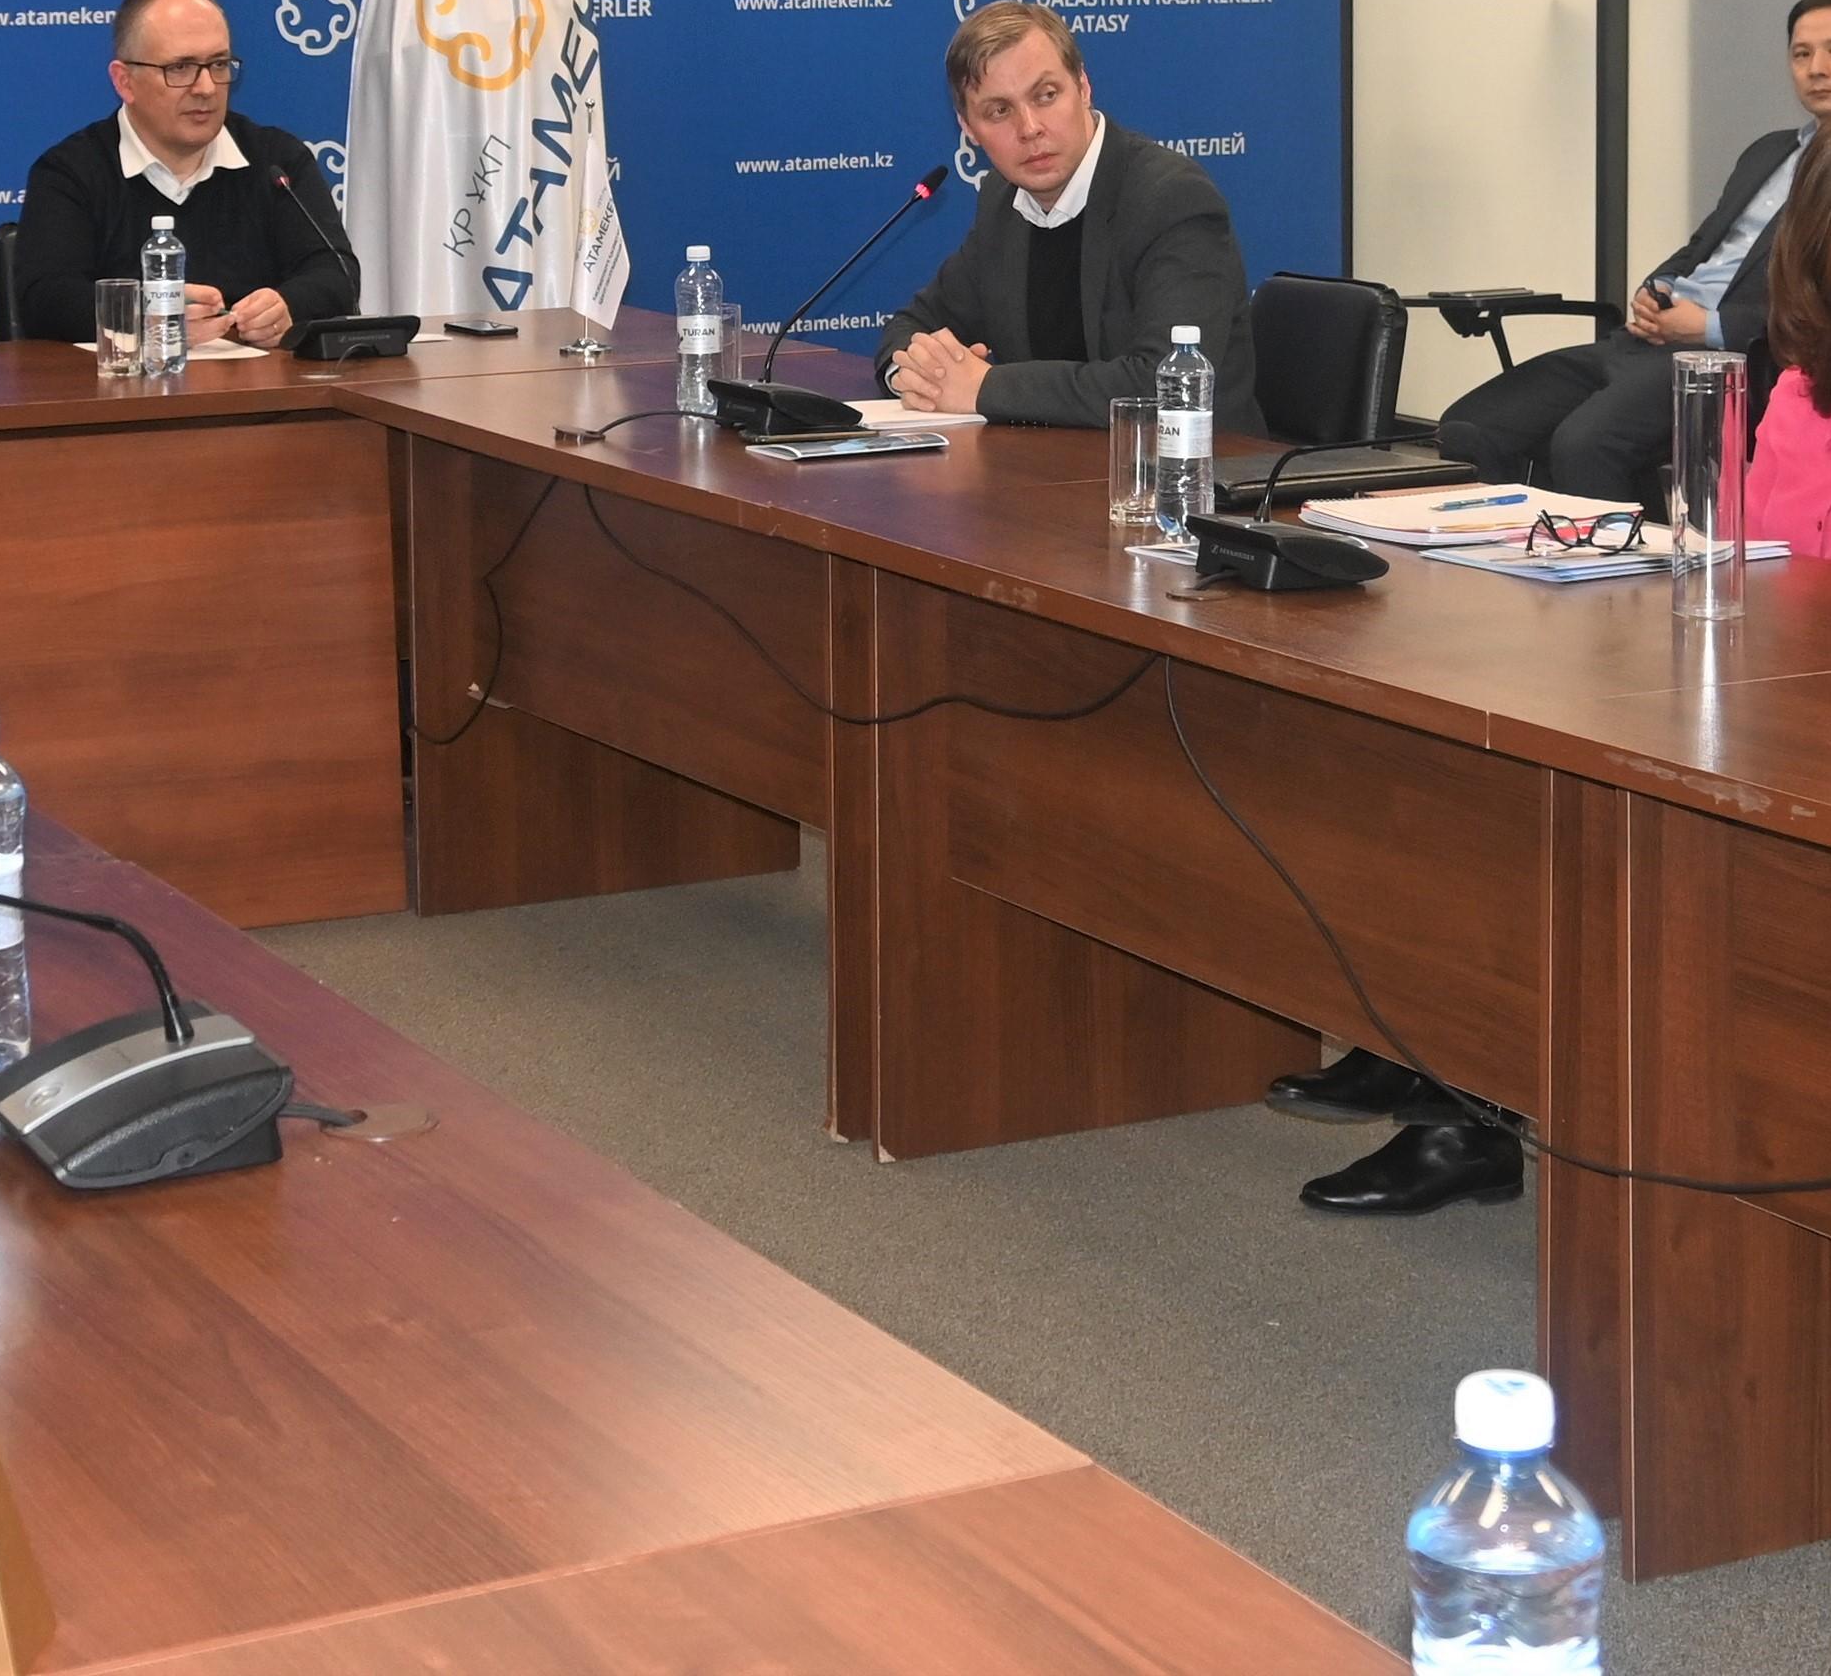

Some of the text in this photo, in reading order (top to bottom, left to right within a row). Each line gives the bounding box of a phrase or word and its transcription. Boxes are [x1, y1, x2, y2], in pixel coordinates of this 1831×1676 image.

[736, 152, 893, 173] www.atameken.kz
[583, 197, 615, 273] АТАМЕКЕ
[683, 328, 715, 337] TURAN
